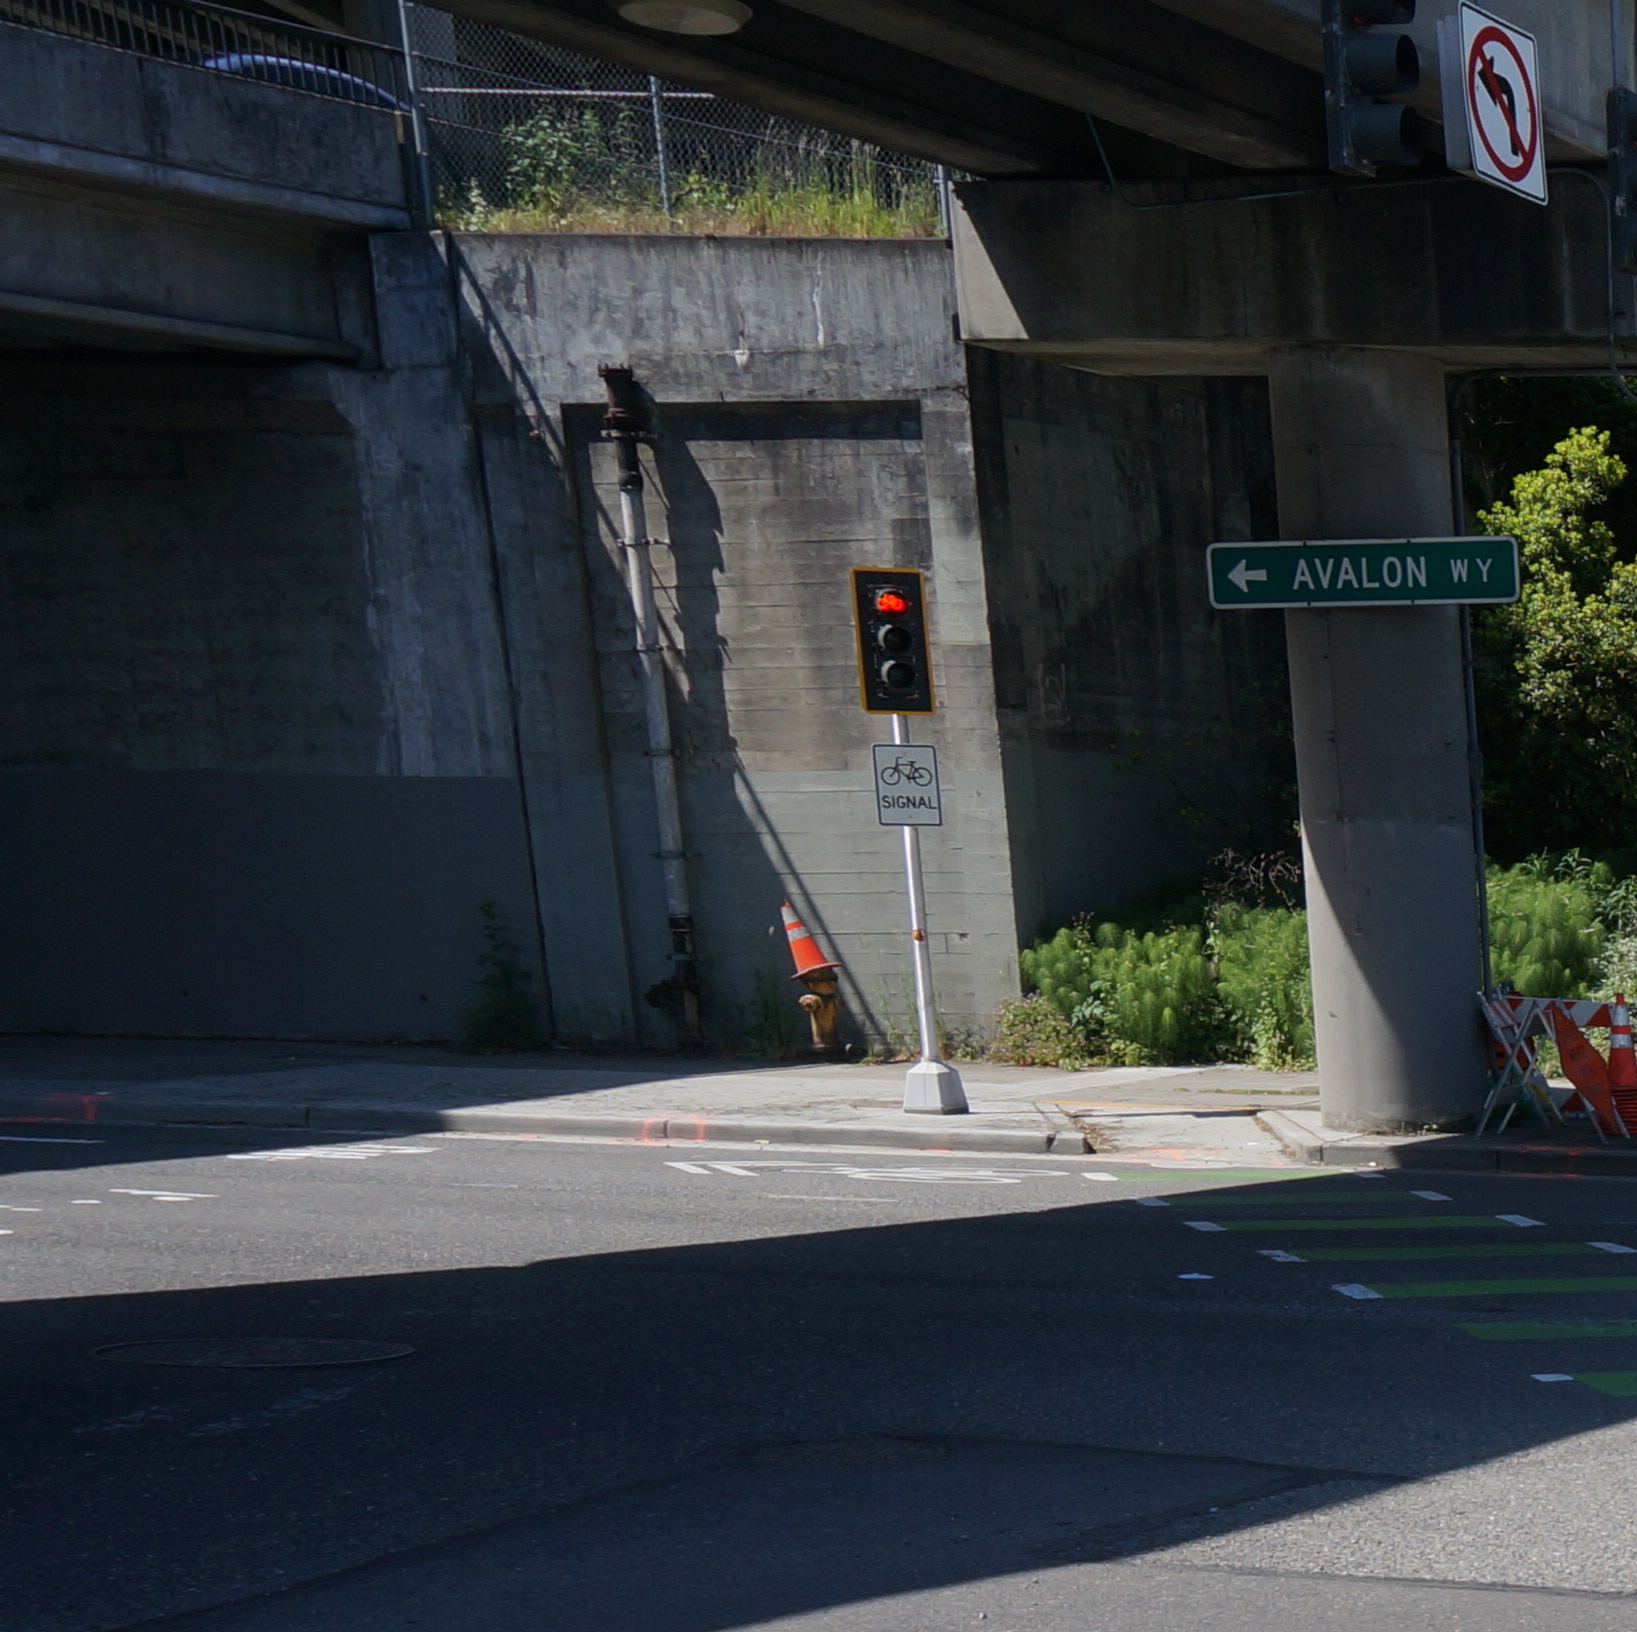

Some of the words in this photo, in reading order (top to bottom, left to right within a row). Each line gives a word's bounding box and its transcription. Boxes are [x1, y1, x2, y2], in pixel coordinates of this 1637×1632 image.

[1293, 556, 1427, 590] AVALON
[1449, 558, 1493, 583] WY
[882, 795, 938, 809] SIGNAL
